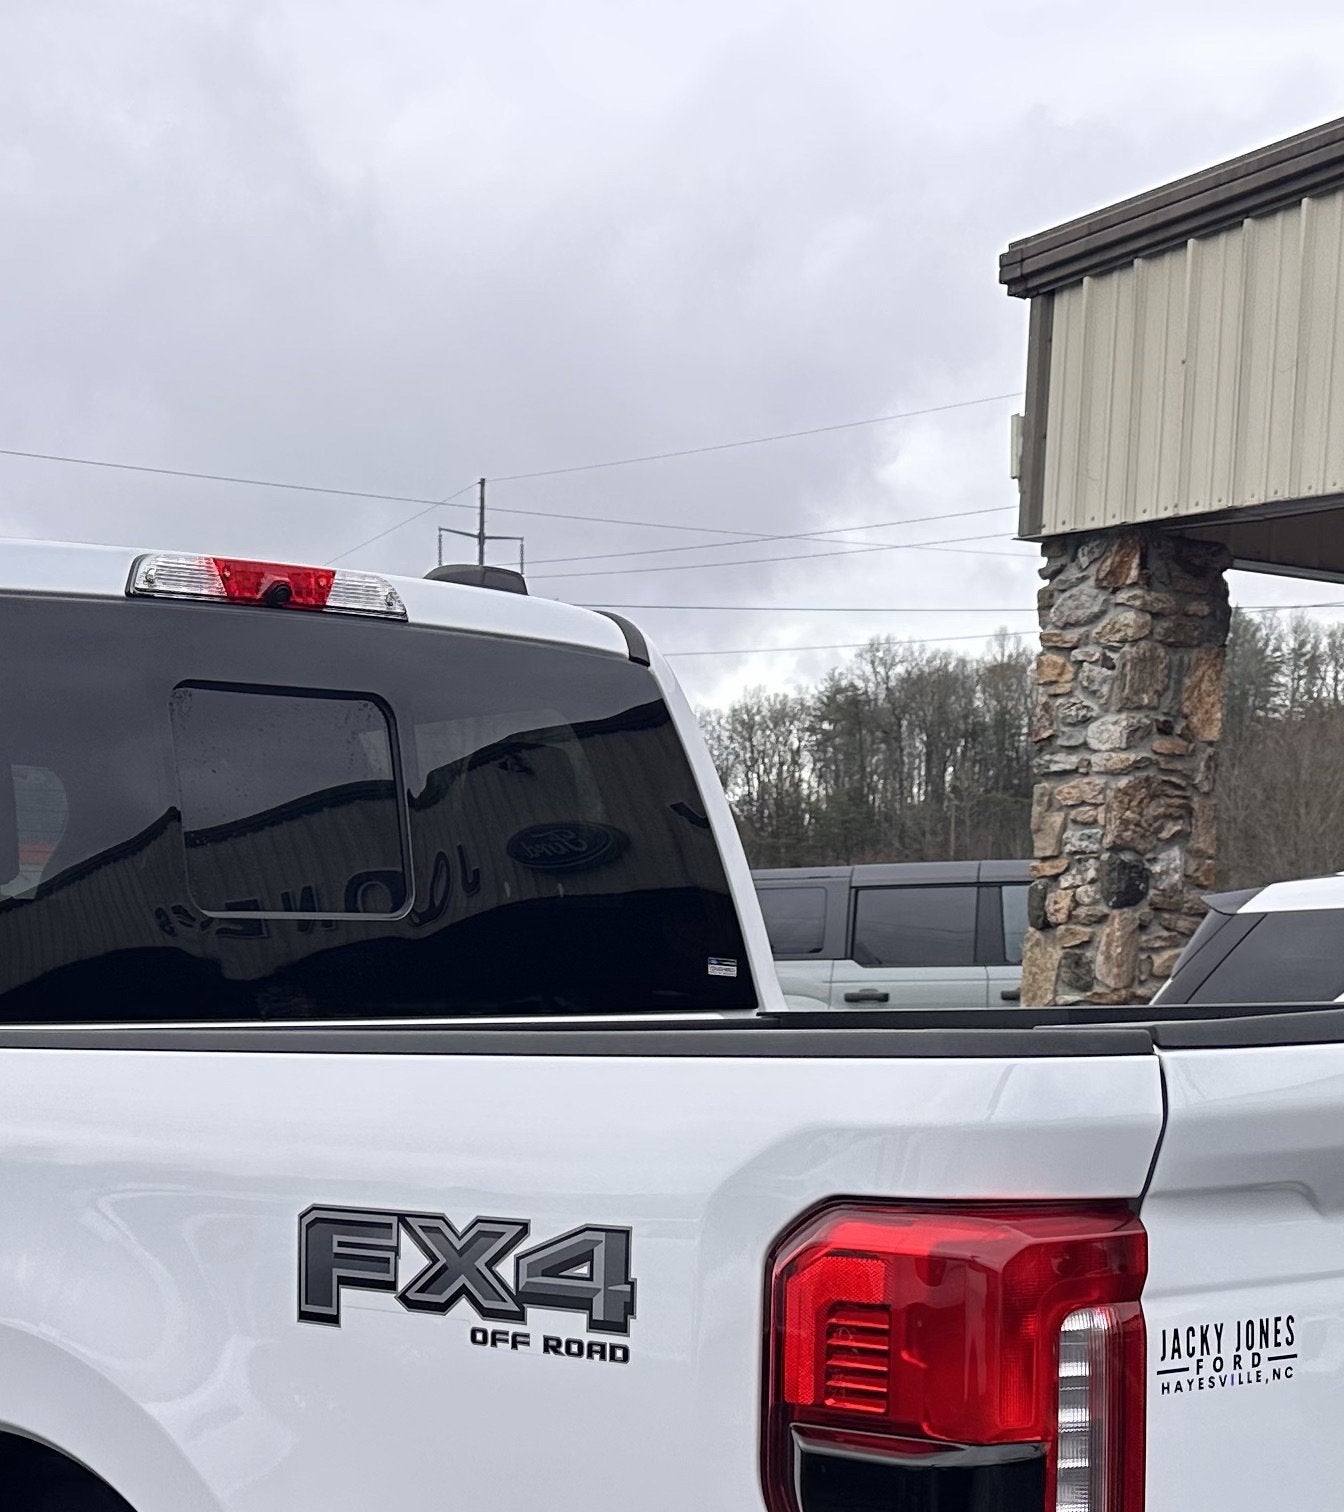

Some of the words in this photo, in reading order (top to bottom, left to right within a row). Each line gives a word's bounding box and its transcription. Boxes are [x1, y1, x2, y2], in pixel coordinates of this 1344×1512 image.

[296, 1202, 638, 1337] FX4
[469, 1326, 531, 1351] OFF
[542, 1334, 631, 1365] ROAD
[1160, 1322, 1225, 1362] JACKY
[1235, 1314, 1296, 1353] JONES
[1196, 1352, 1262, 1375] FORD
